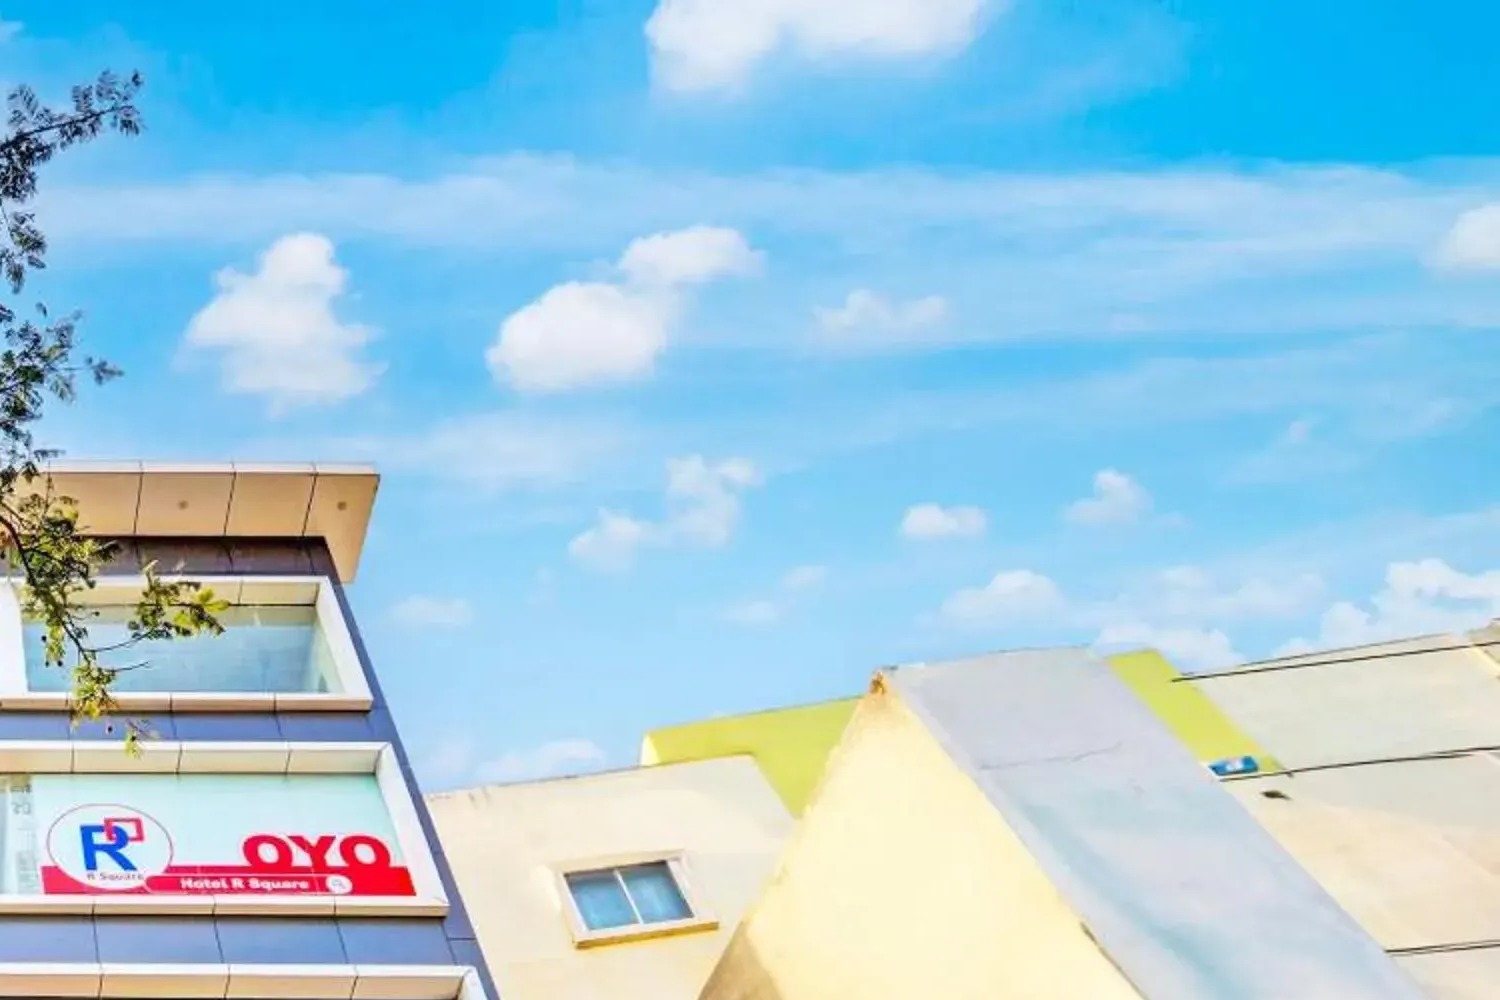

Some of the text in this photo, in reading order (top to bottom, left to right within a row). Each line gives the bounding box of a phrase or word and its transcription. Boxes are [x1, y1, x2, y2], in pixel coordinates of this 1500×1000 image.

[243, 834, 391, 870] OYO
[180, 877, 309, 891] Hotel R Square
